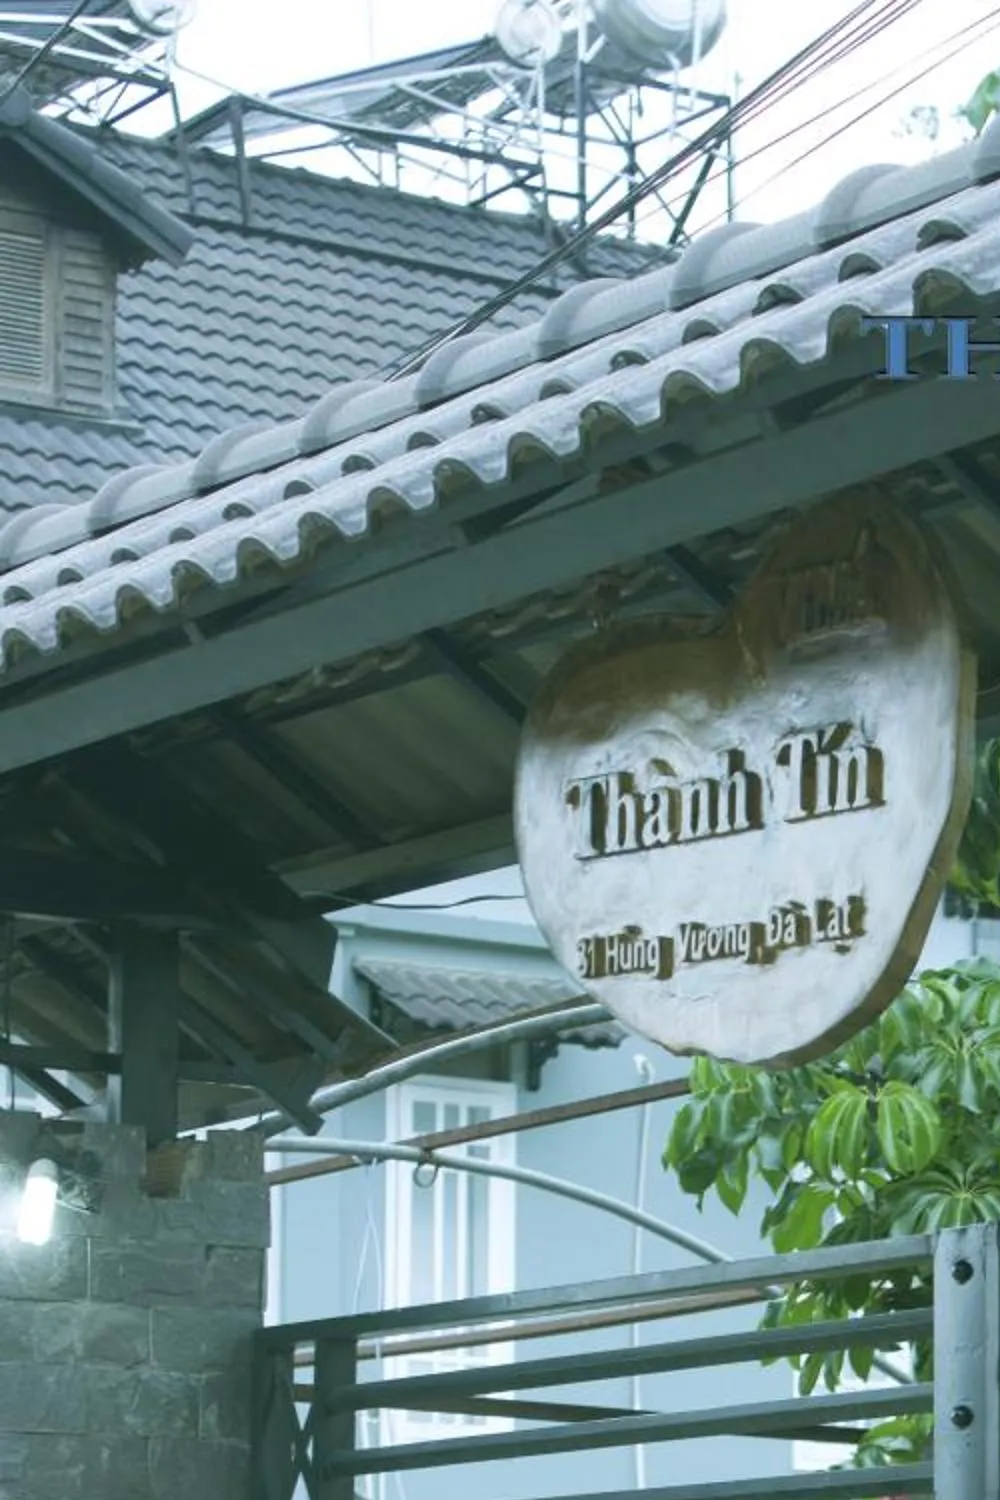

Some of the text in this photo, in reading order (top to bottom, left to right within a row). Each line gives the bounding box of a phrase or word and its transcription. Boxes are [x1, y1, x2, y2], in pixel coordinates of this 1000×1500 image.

[562, 722, 882, 861] Thành Tín
[575, 937, 598, 979] 31
